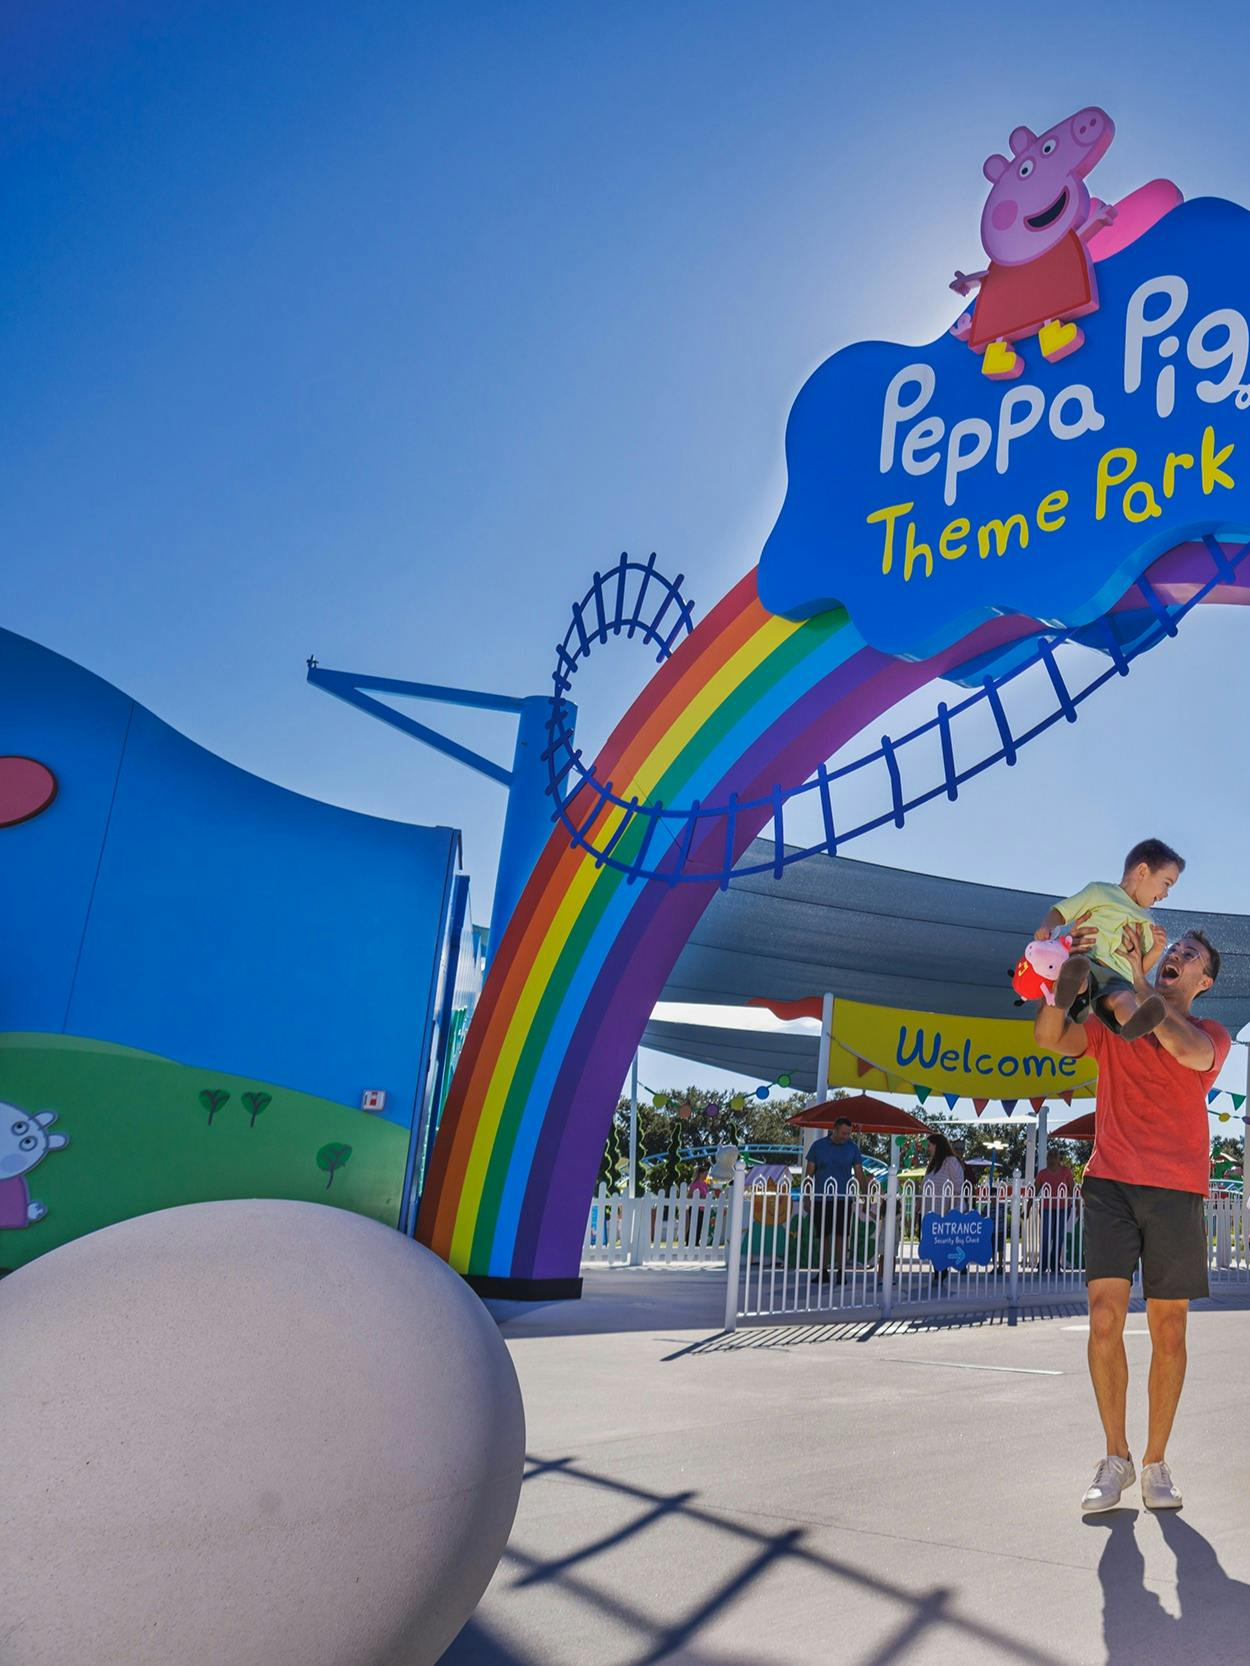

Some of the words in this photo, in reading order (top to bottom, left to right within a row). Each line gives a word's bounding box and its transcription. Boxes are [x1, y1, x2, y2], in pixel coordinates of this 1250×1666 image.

[880, 364, 1105, 505] Peppa
[866, 489, 1069, 581] Theme
[1096, 426, 1236, 523] Park
[896, 1025, 1077, 1077] Welcome
[931, 1222, 982, 1235] ENTRANCE
